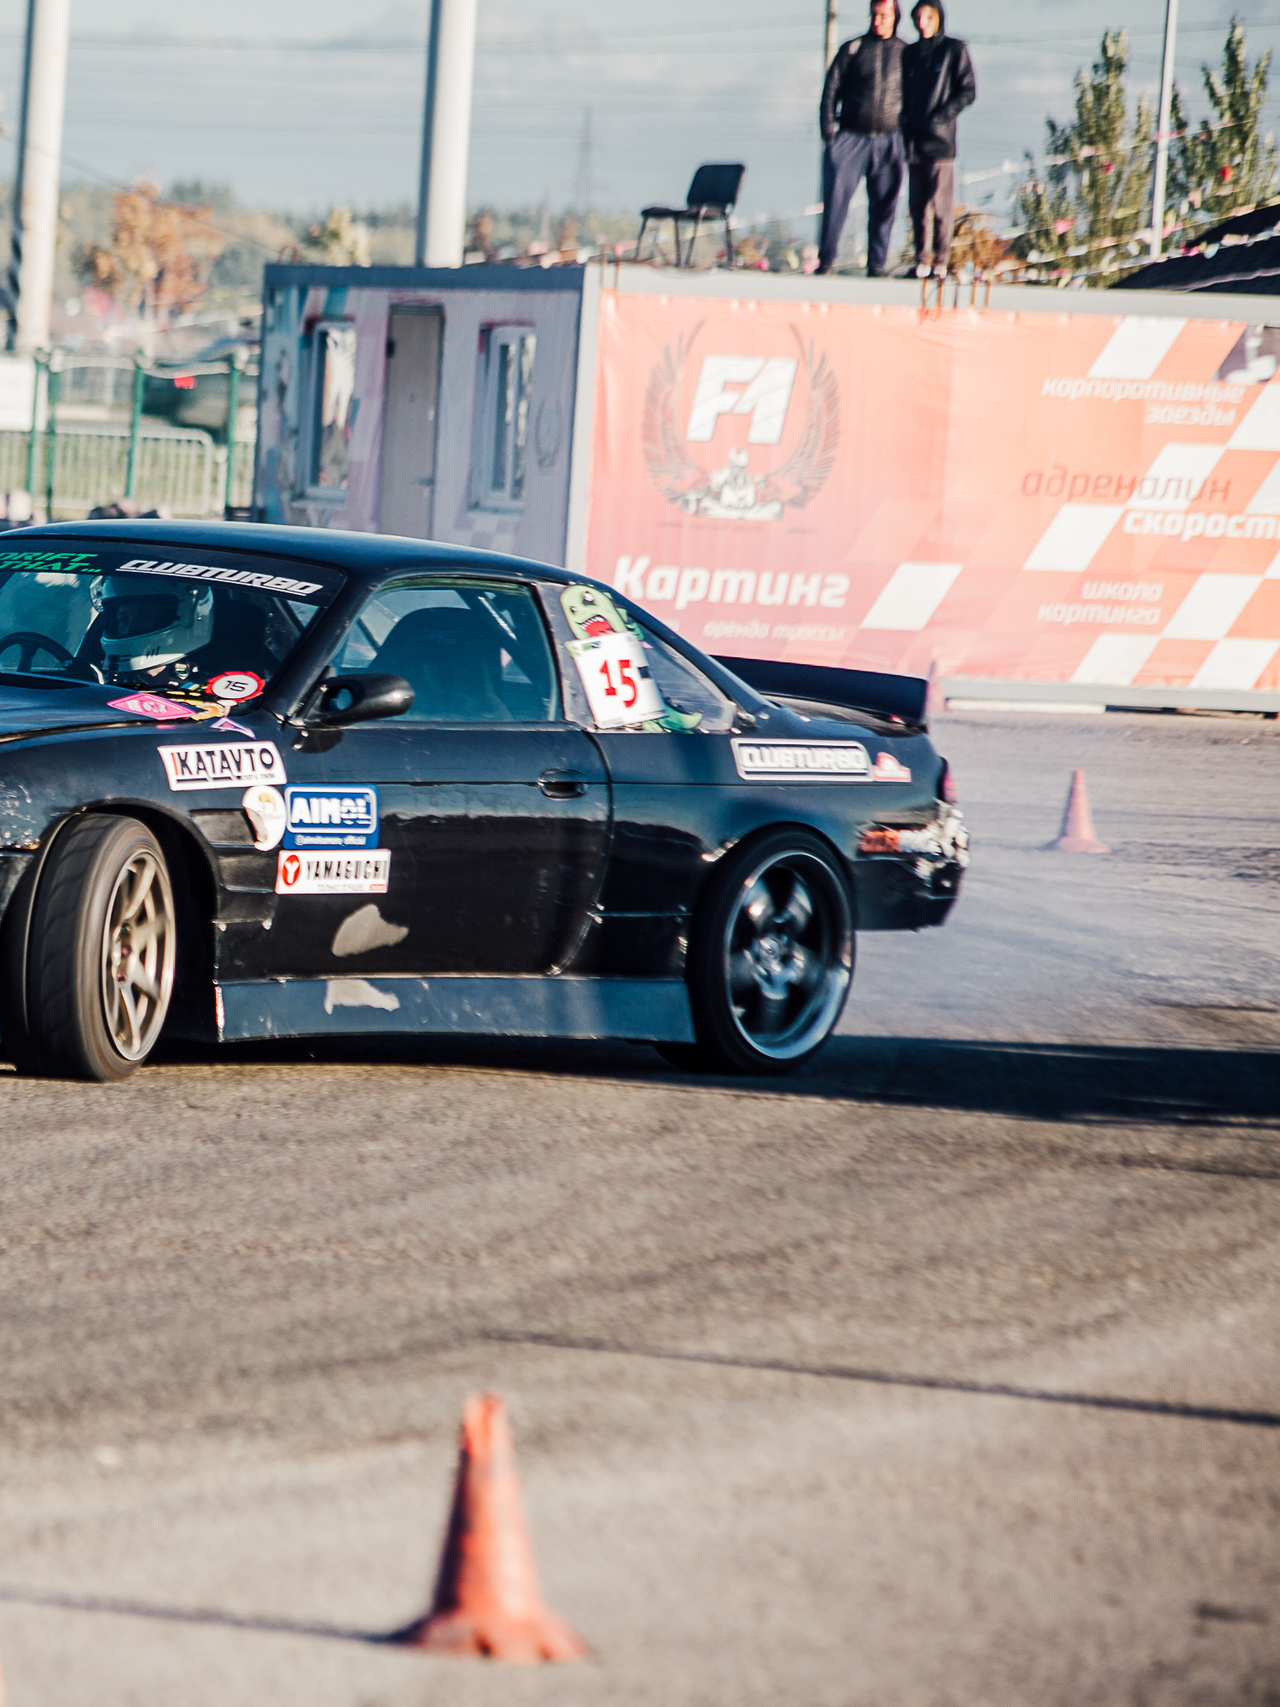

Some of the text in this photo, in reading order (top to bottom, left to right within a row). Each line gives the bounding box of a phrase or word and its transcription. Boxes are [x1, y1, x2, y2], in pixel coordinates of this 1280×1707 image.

[1041, 377, 1246, 403] корпоративные
[1144, 403, 1237, 426] заезды
[1022, 465, 1232, 503] адреналин
[120, 559, 323, 595] CLUBTURBO
[613, 555, 851, 611] Картинг
[1081, 581, 1164, 601] школа
[1037, 602, 1162, 626] картинга
[224, 680, 249, 692] 15
[599, 659, 638, 709] 15
[742, 746, 867, 770] CLUBTURBO
[306, 860, 388, 880] YAMAGUCHI
